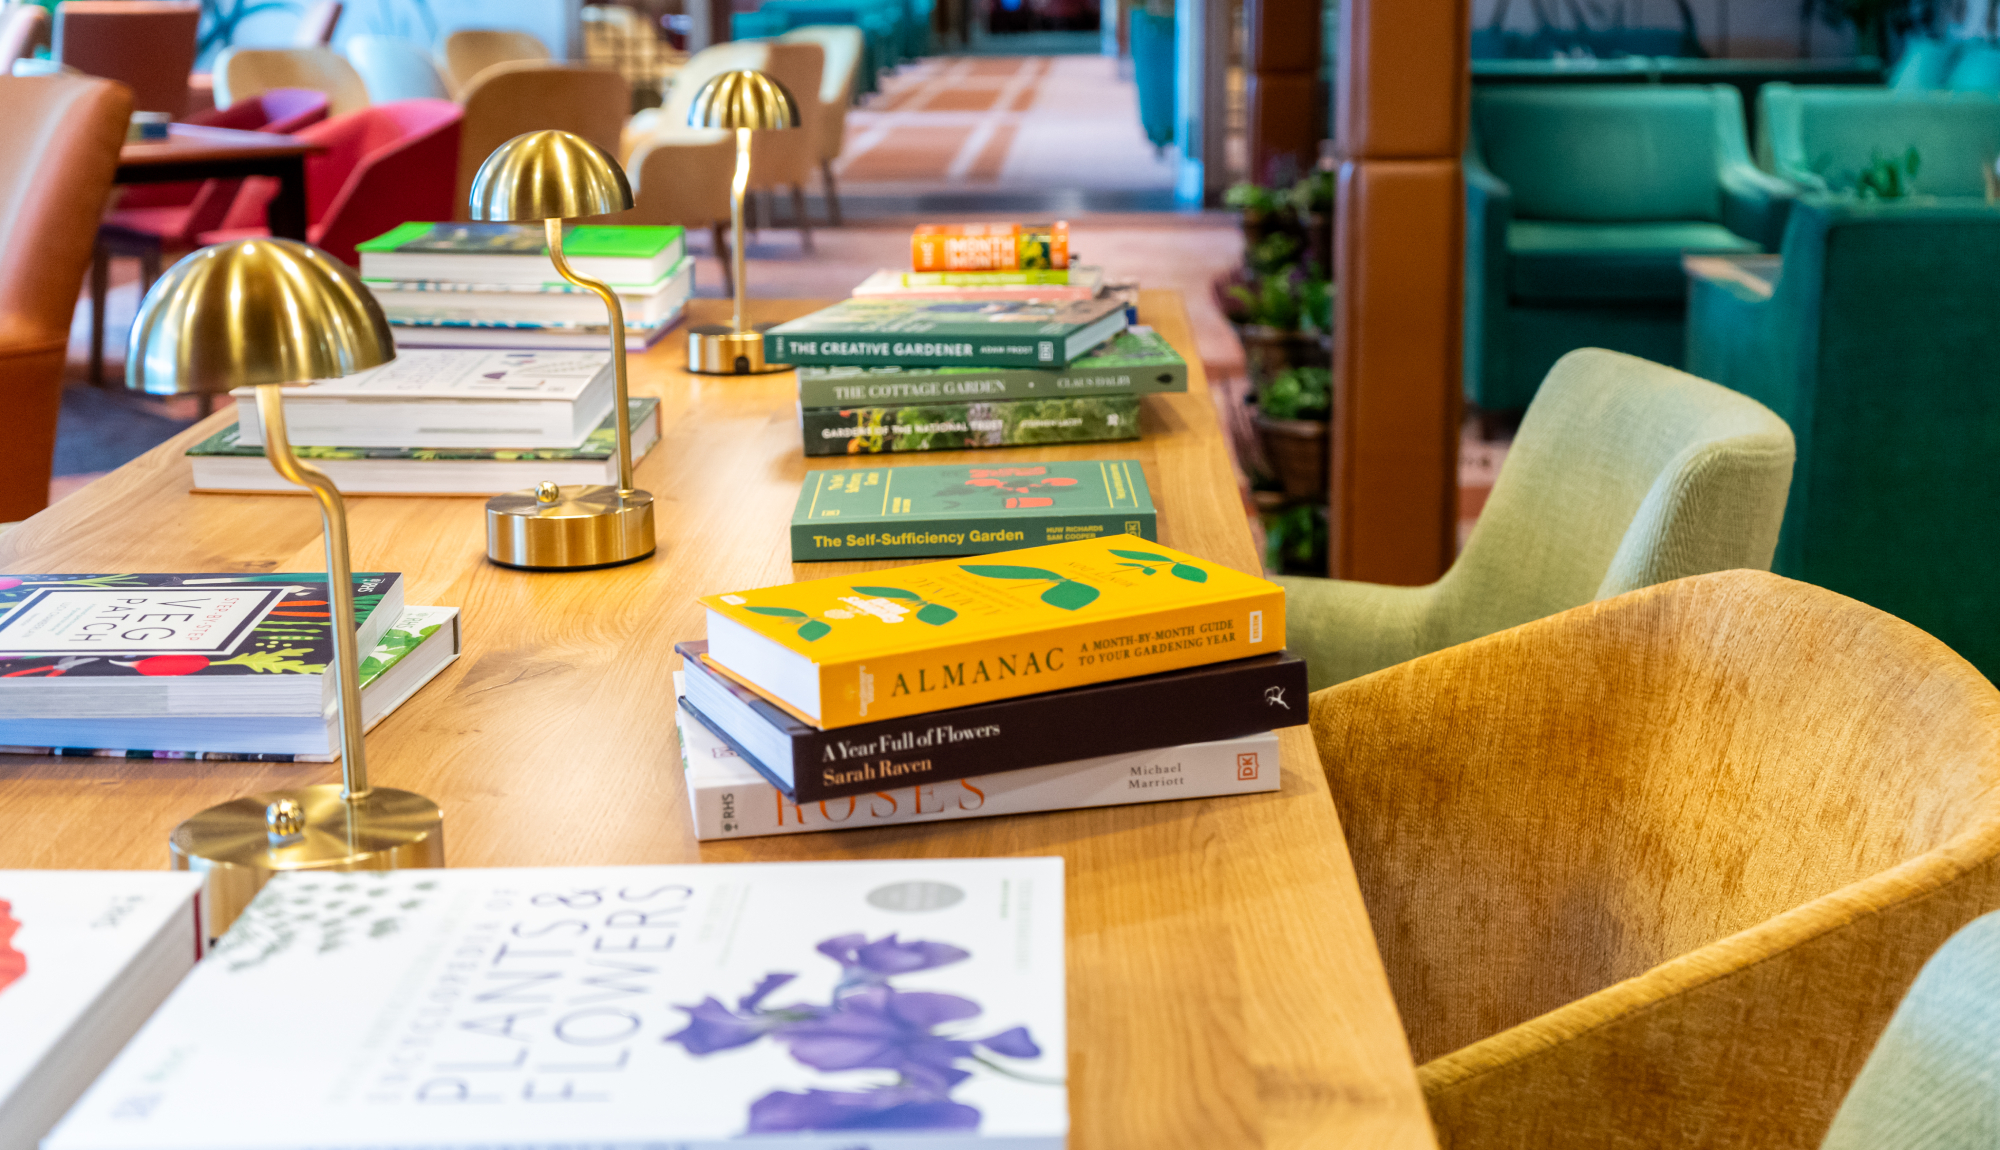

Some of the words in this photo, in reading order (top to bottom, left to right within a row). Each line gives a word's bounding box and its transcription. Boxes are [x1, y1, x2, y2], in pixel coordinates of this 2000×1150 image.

[789, 341, 818, 355] THE
[820, 342, 890, 356] CREATIVE
[893, 343, 973, 357] GARDENER
[833, 385, 866, 400] THE
[868, 382, 941, 398] COTTAGE
[943, 379, 1006, 394] GARDEN
[822, 427, 872, 440] GARDENS
[915, 421, 968, 434] NATIONAL
[813, 535, 842, 548] The
[846, 531, 965, 547] Self-Sufficiency
[969, 529, 1024, 543] Garden
[1065, 525, 1104, 533] RICHARDS
[357, 582, 379, 593] RHS
[68, 598, 149, 642] PATCH
[120, 597, 212, 641] VEG
[185, 597, 240, 641] STEP-BY-STEP
[396, 618, 423, 629] RHS
[1078, 655, 1095, 667] TO
[1098, 647, 1131, 663] YOUR
[1134, 637, 1204, 657] GARDENING
[1206, 631, 1236, 645] YEAR
[1080, 642, 1089, 653] A
[1092, 624, 1195, 651] MONTH-BY-MONTH
[1199, 619, 1234, 634] GUIDE
[892, 647, 1065, 698] ALMANAC
[822, 744, 837, 763] A
[838, 740, 878, 760] Year
[879, 732, 914, 755] Full
[916, 729, 934, 748] of
[936, 722, 1000, 746] Flowers
[822, 763, 876, 788] Sarah
[879, 757, 933, 779] Raven
[1130, 762, 1182, 776] Michael
[1241, 755, 1254, 778] DK
[1128, 777, 1184, 789] Marriott
[721, 792, 735, 820] RHS
[415, 918, 590, 1103] PLANTS
[530, 887, 603, 911] &
[521, 883, 694, 1103] FLOWERS
